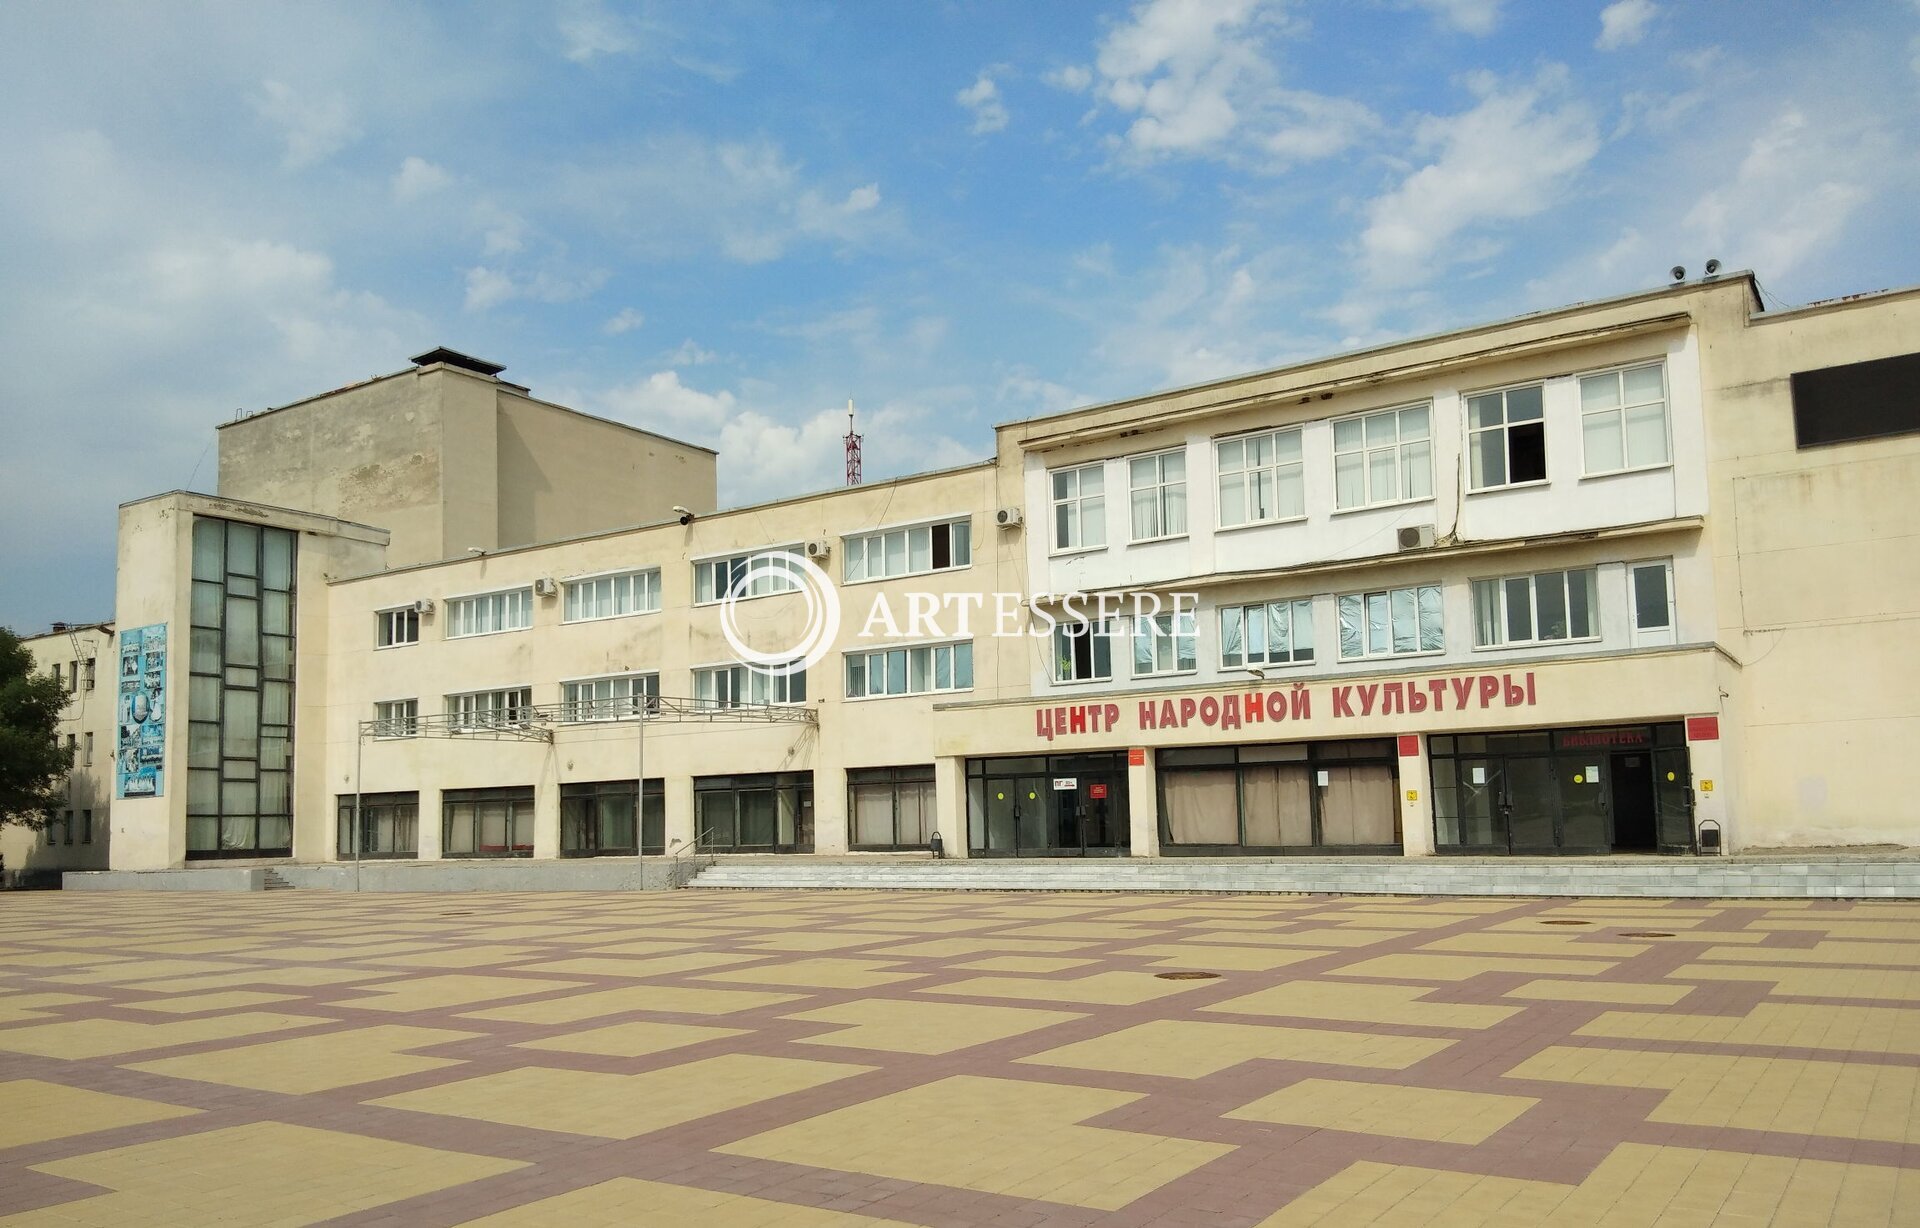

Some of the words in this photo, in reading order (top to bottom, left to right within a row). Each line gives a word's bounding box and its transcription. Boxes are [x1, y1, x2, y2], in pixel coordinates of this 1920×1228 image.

[1036, 703, 1120, 741] ЦЕНТР
[1138, 682, 1311, 731] НАРОДНОЙ
[1332, 672, 1537, 718] КУЛЬТУРЫ
